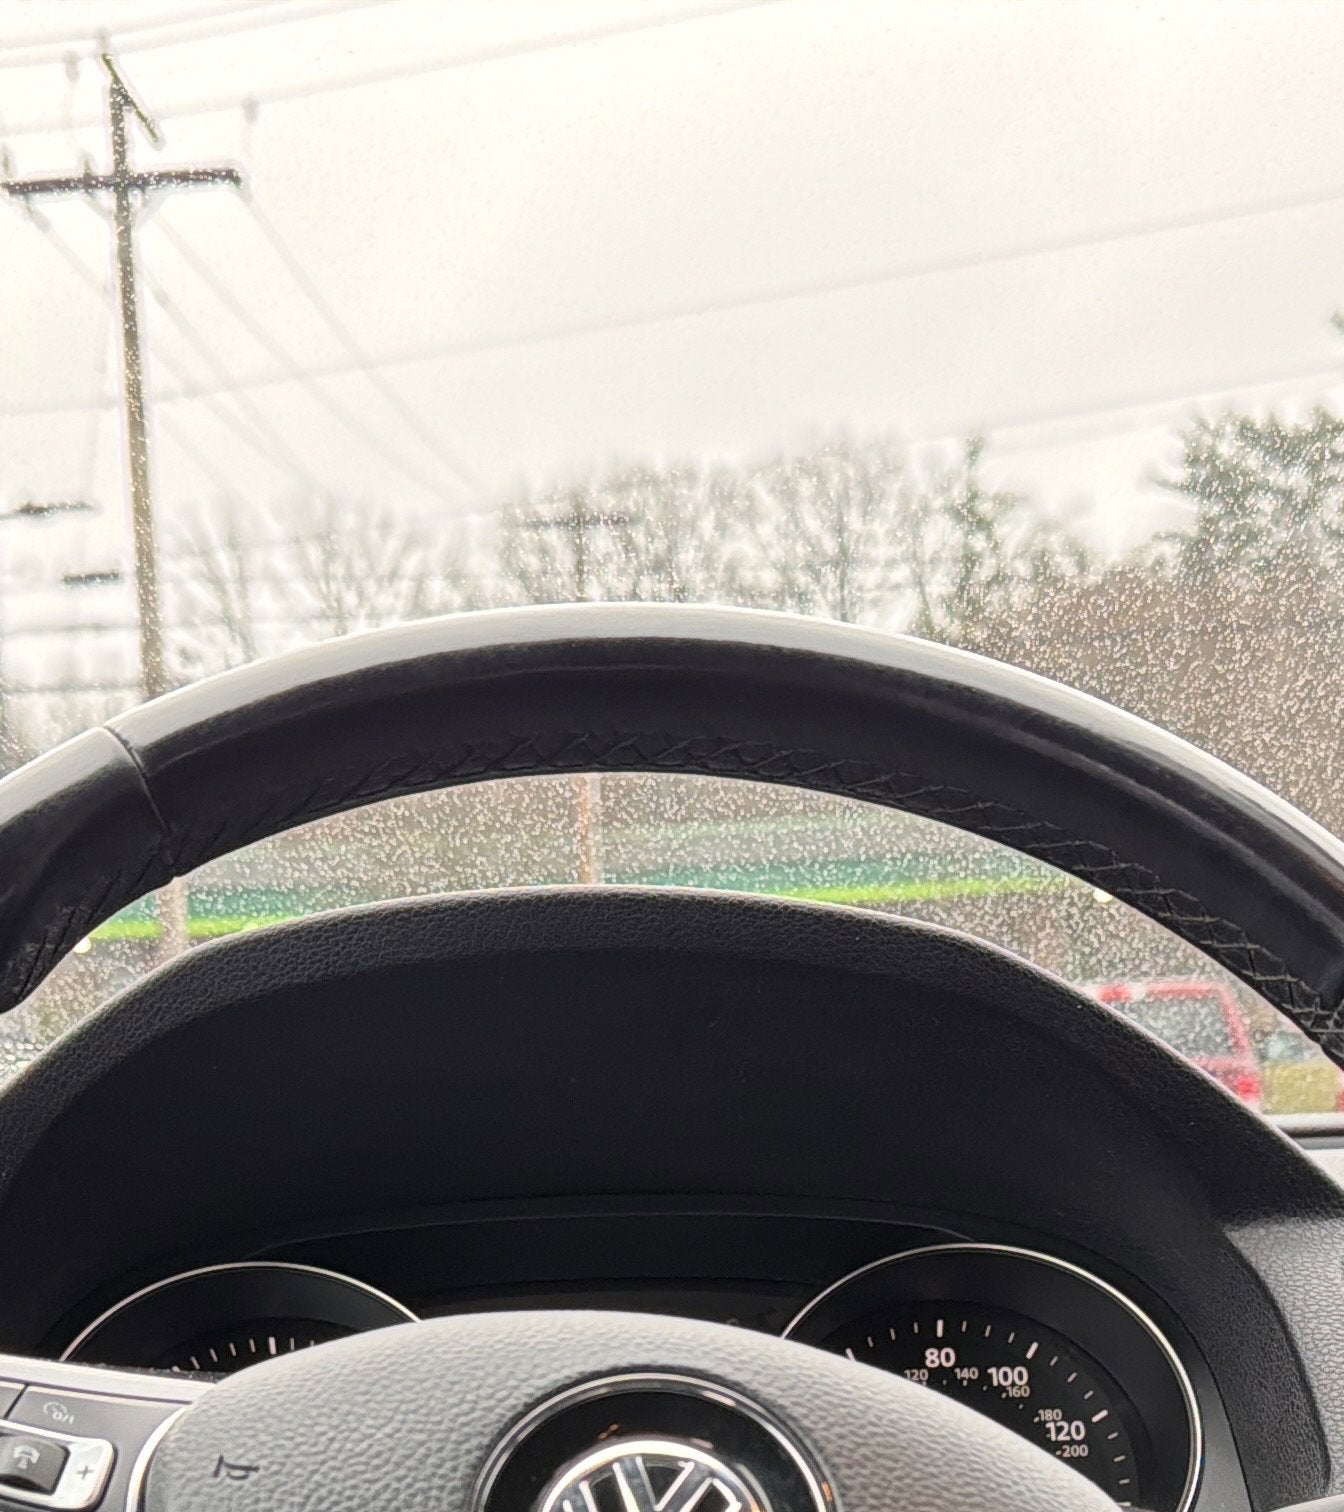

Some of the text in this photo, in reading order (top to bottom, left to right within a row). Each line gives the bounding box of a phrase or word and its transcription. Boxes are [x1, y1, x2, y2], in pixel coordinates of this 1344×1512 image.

[925, 1347, 956, 1368] 80
[955, 1367, 979, 1380] 140
[987, 1366, 1029, 1387] 100
[1007, 1386, 1030, 1398] 160
[1039, 1408, 1063, 1421] 180
[1045, 1421, 1086, 1442] 120
[1062, 1445, 1088, 1457] 200
